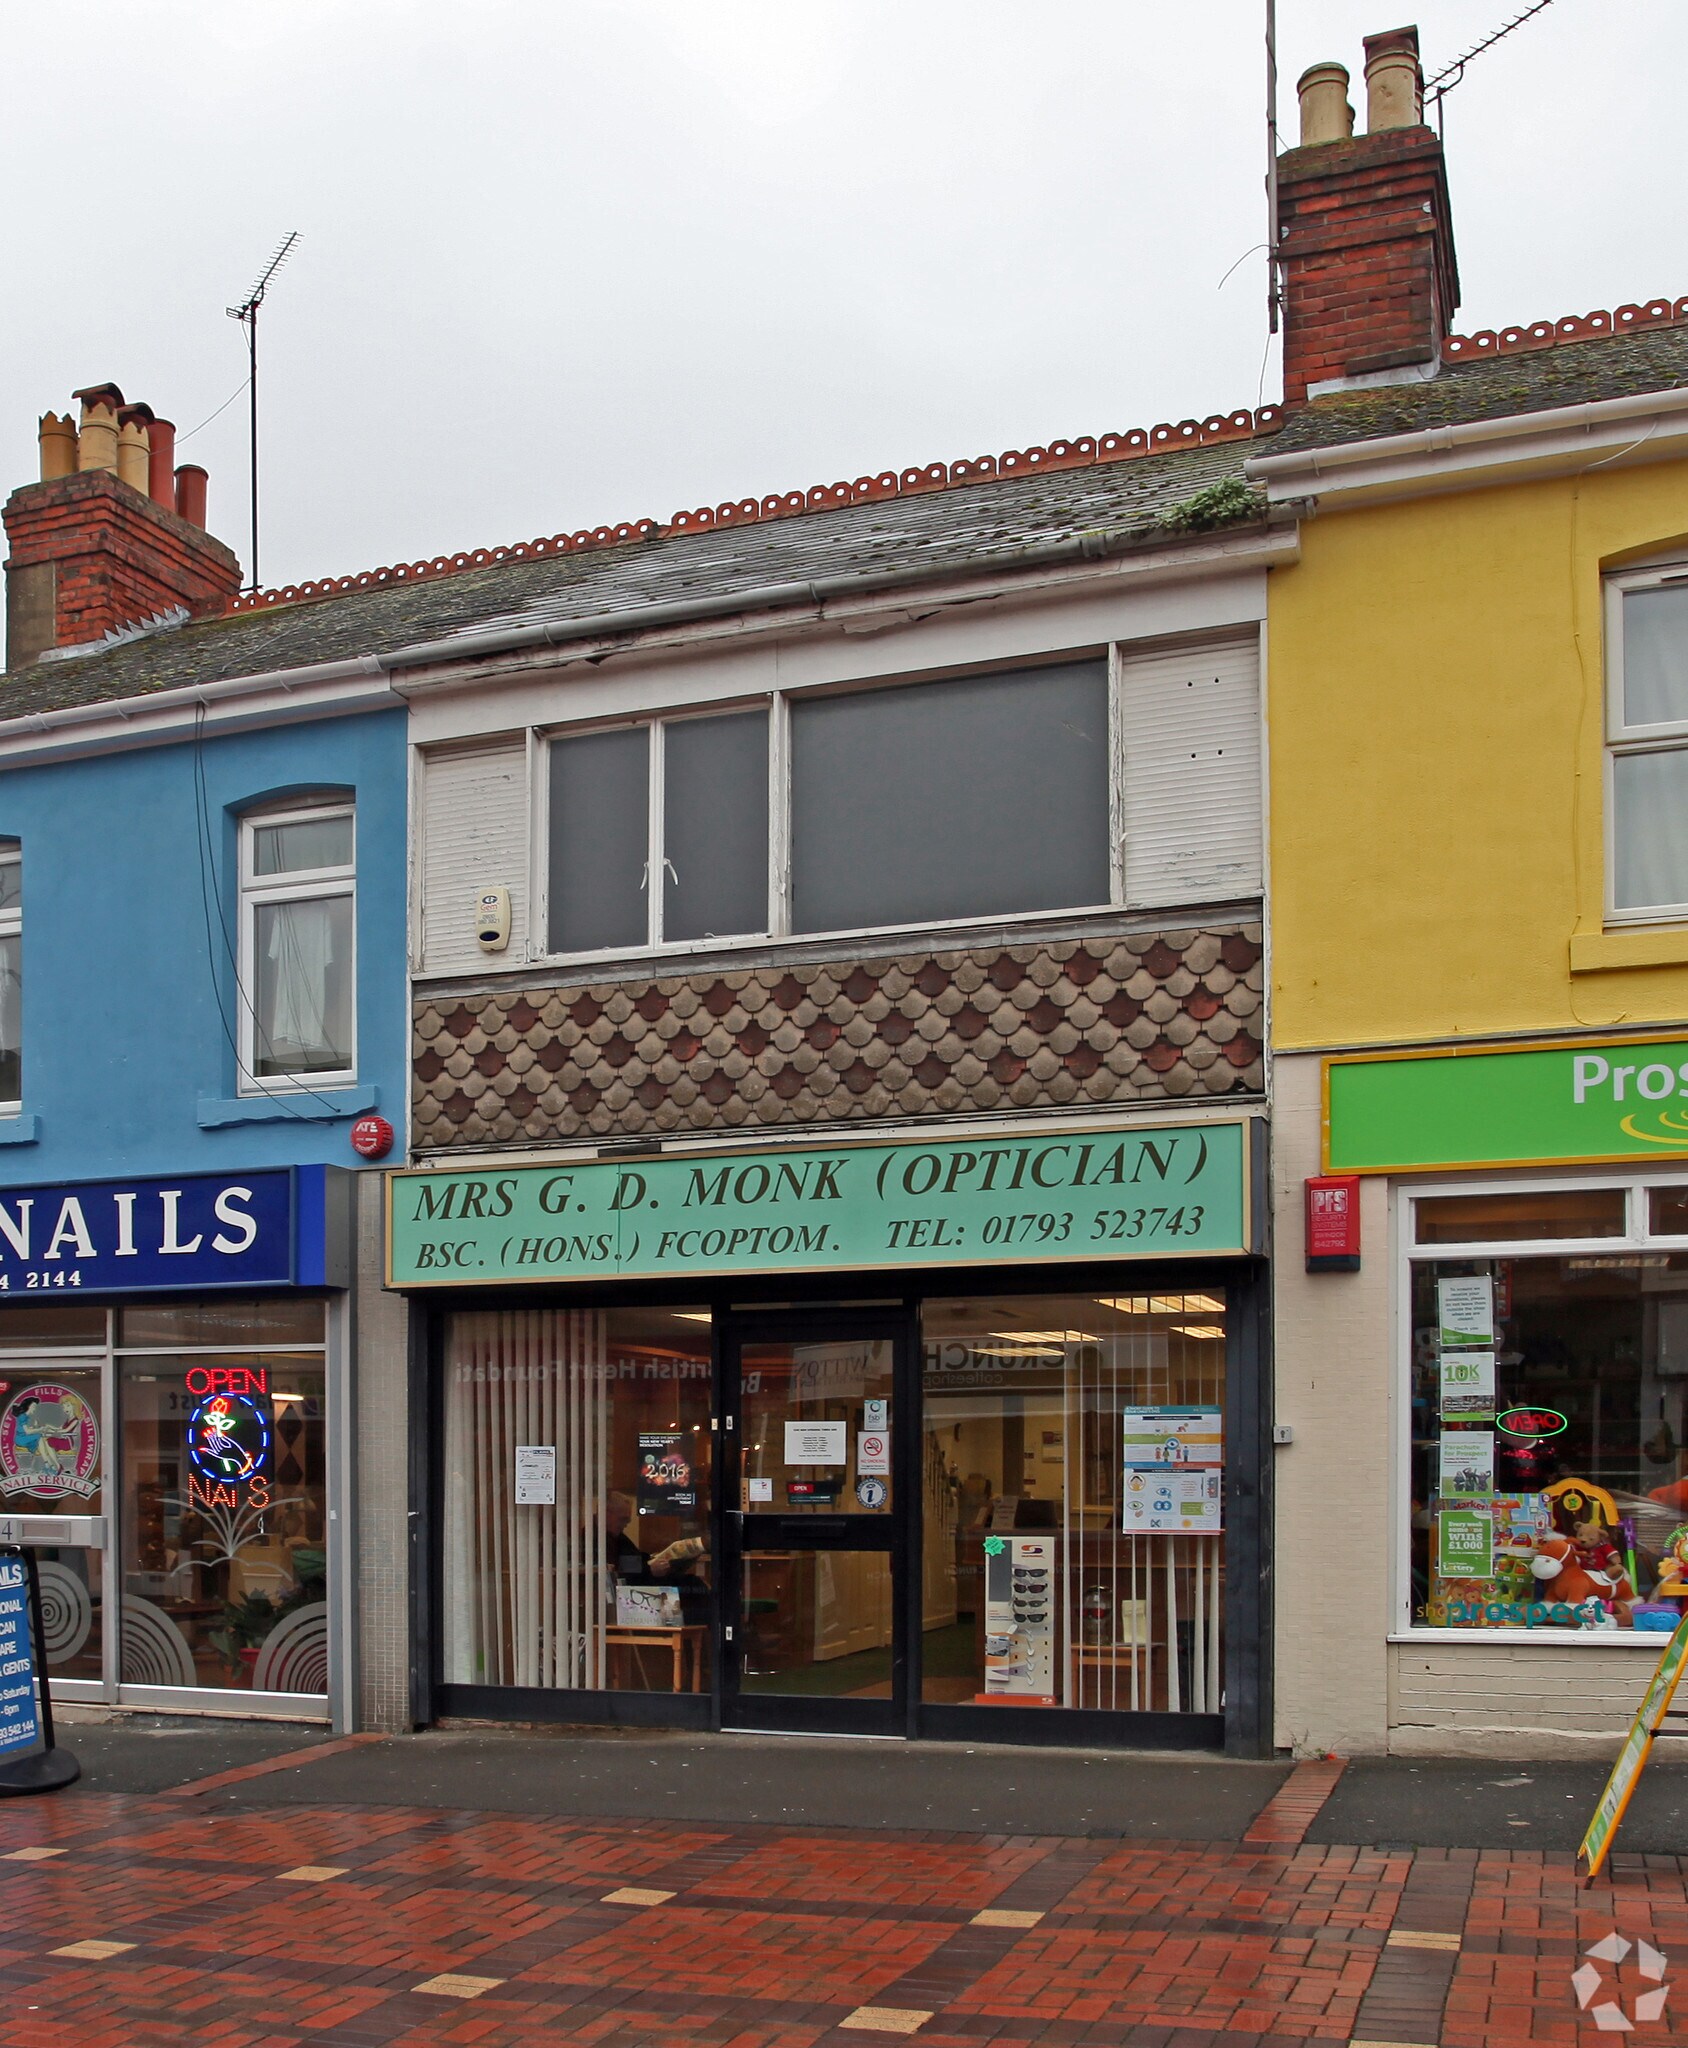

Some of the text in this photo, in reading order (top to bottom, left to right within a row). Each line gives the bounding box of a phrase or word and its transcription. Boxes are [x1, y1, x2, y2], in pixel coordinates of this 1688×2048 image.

[356, 1121, 378, 1132] ATE
[412, 1178, 519, 1221] MRS
[538, 1175, 586, 1214] G.
[608, 1172, 659, 1211] D.
[681, 1157, 850, 1207] MONK
[1313, 1191, 1346, 1213] PFS
[415, 1205, 1205, 1269] BSC. (HONS.) FCOPTOM. TEL: 01793 523743
[26, 1270, 82, 1288] 2144
[186, 1367, 268, 1394] OPEN
[34, 1388, 63, 1397] FILLS
[2, 1441, 16, 1471] FULL
[645, 1463, 686, 1479] 2016
[4, 1474, 91, 1493] NAIL SERVICE
[188, 1473, 270, 1508] NAIS
[1446, 1600, 1607, 1629] prospect
[2, 1658, 31, 1676] GENTS
[3, 1685, 31, 1700] Saturday
